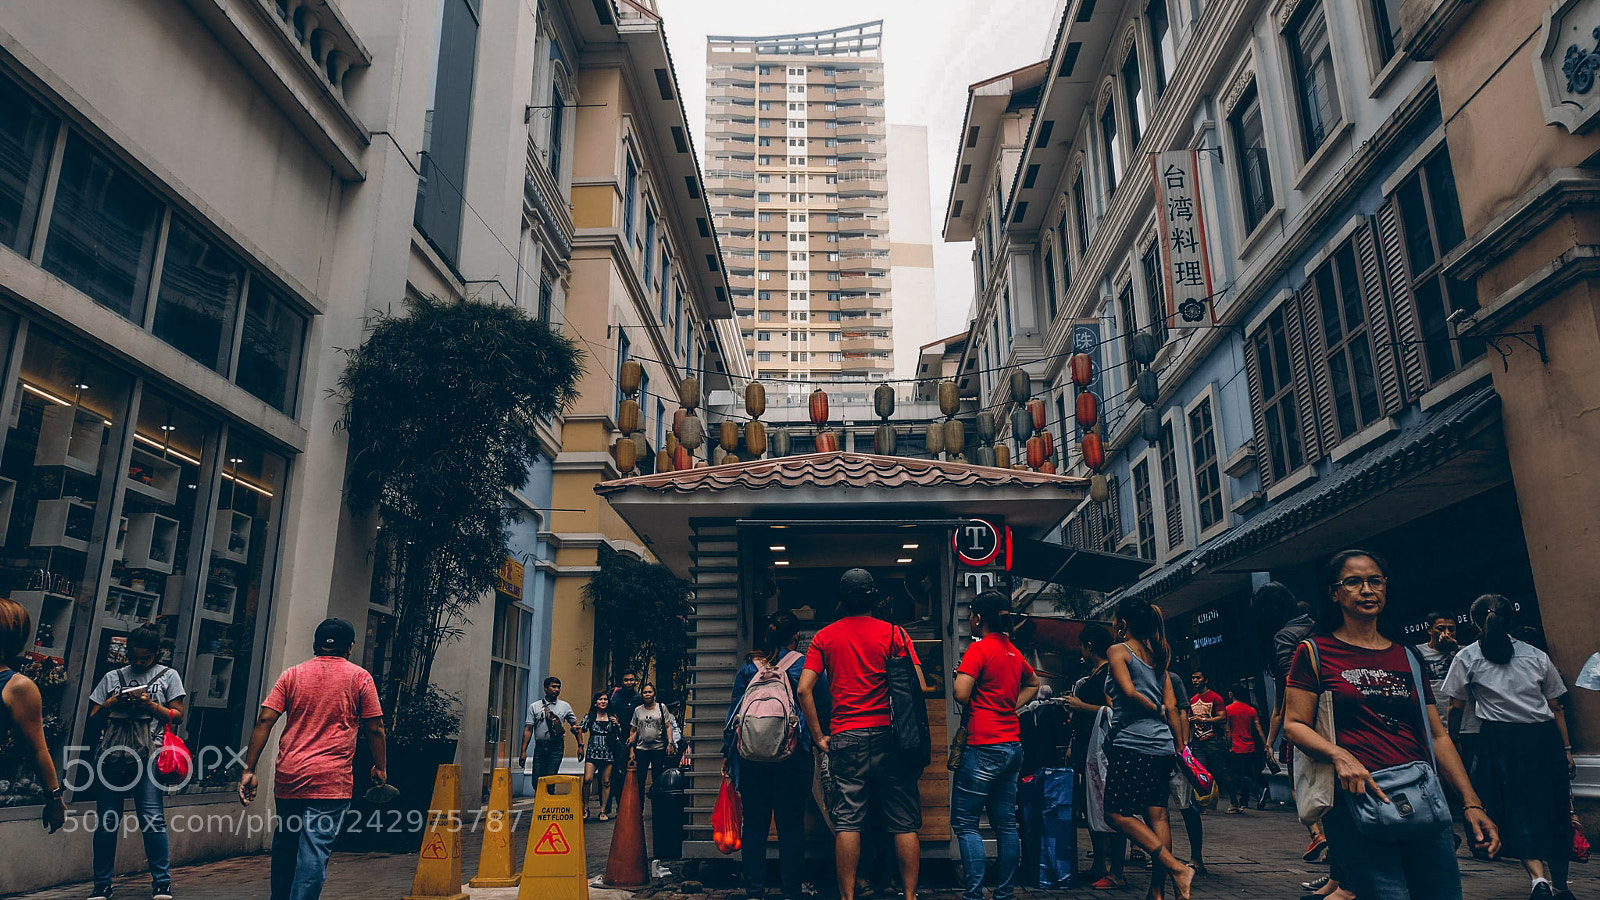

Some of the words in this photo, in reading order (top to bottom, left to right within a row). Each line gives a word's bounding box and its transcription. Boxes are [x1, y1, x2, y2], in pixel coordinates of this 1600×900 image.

[1164, 164, 1204, 286] 台湾料理
[965, 526, 987, 550] T
[551, 813, 574, 821] FLOOR
